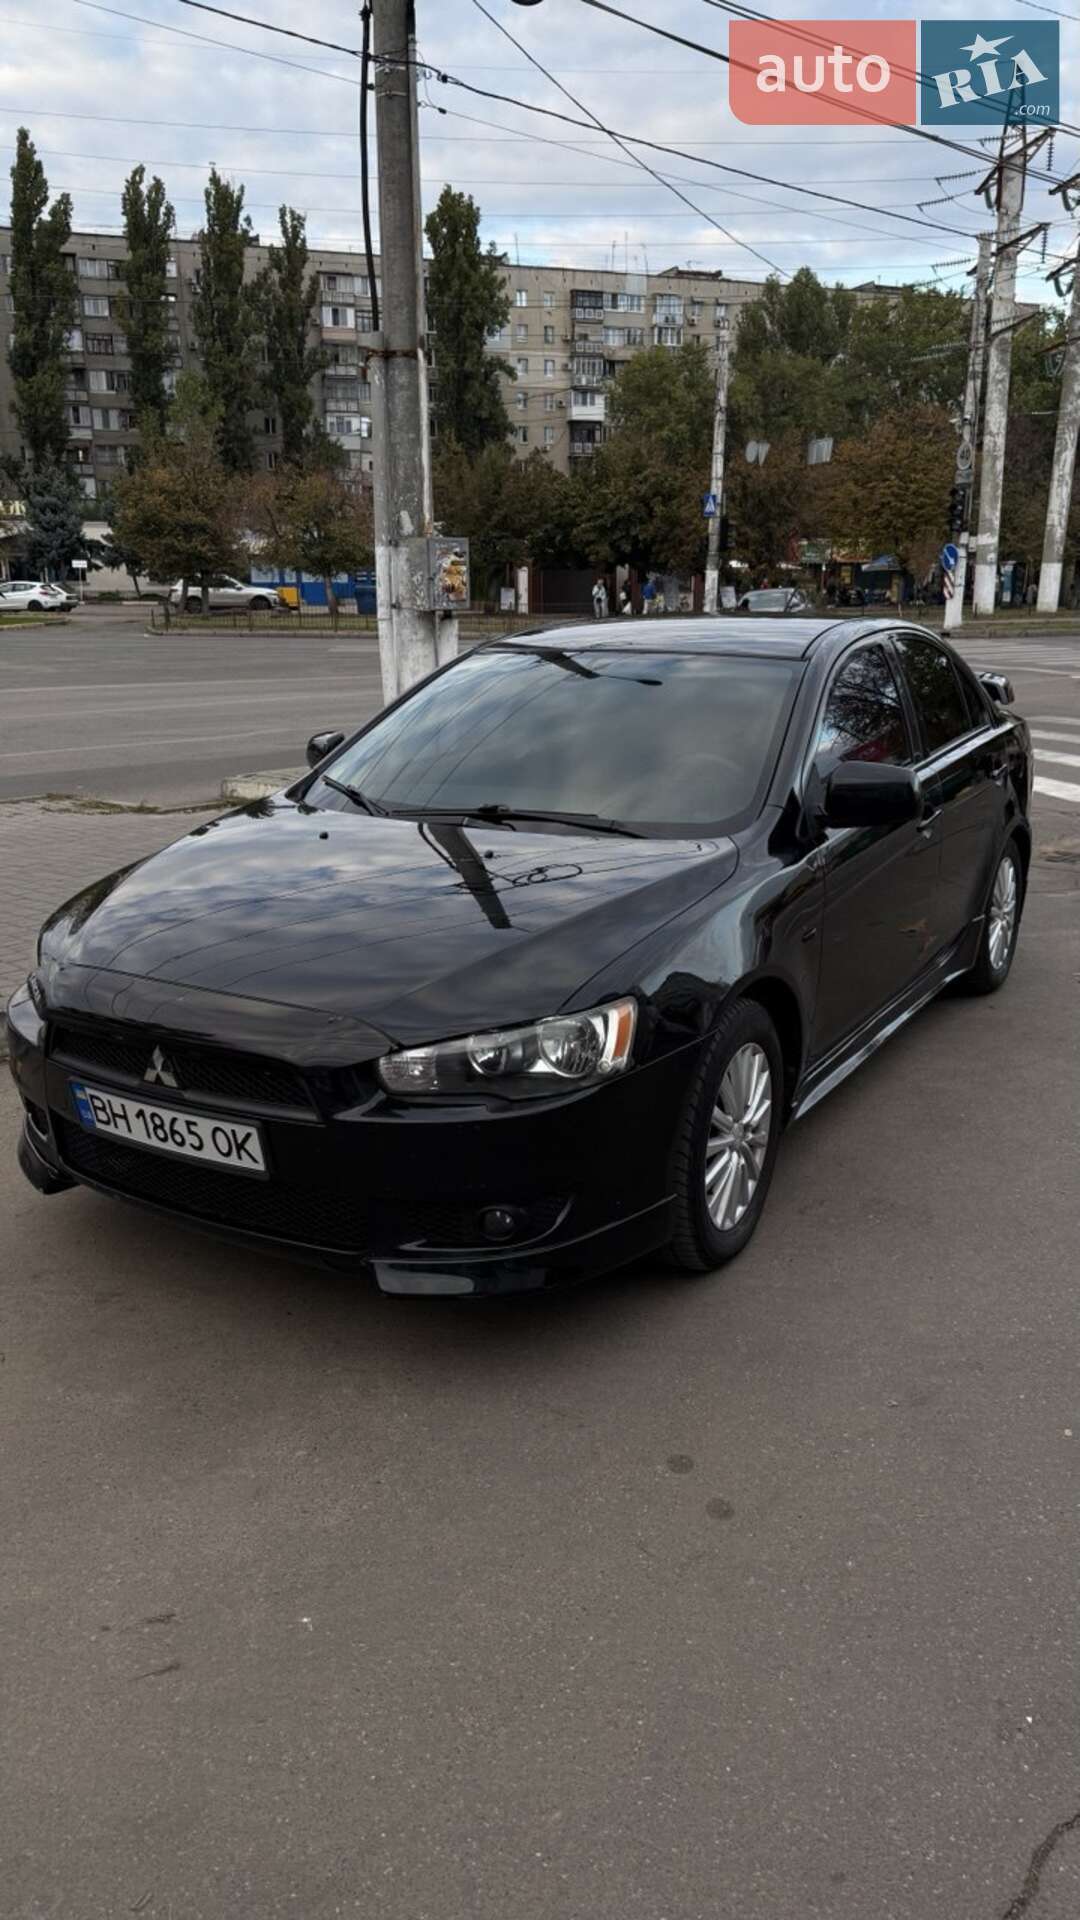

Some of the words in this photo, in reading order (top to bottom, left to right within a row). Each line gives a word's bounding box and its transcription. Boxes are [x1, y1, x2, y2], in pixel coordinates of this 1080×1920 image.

[89, 1094, 132, 1133] BH
[135, 1108, 204, 1151] 1865
[211, 1126, 259, 1164] OK
